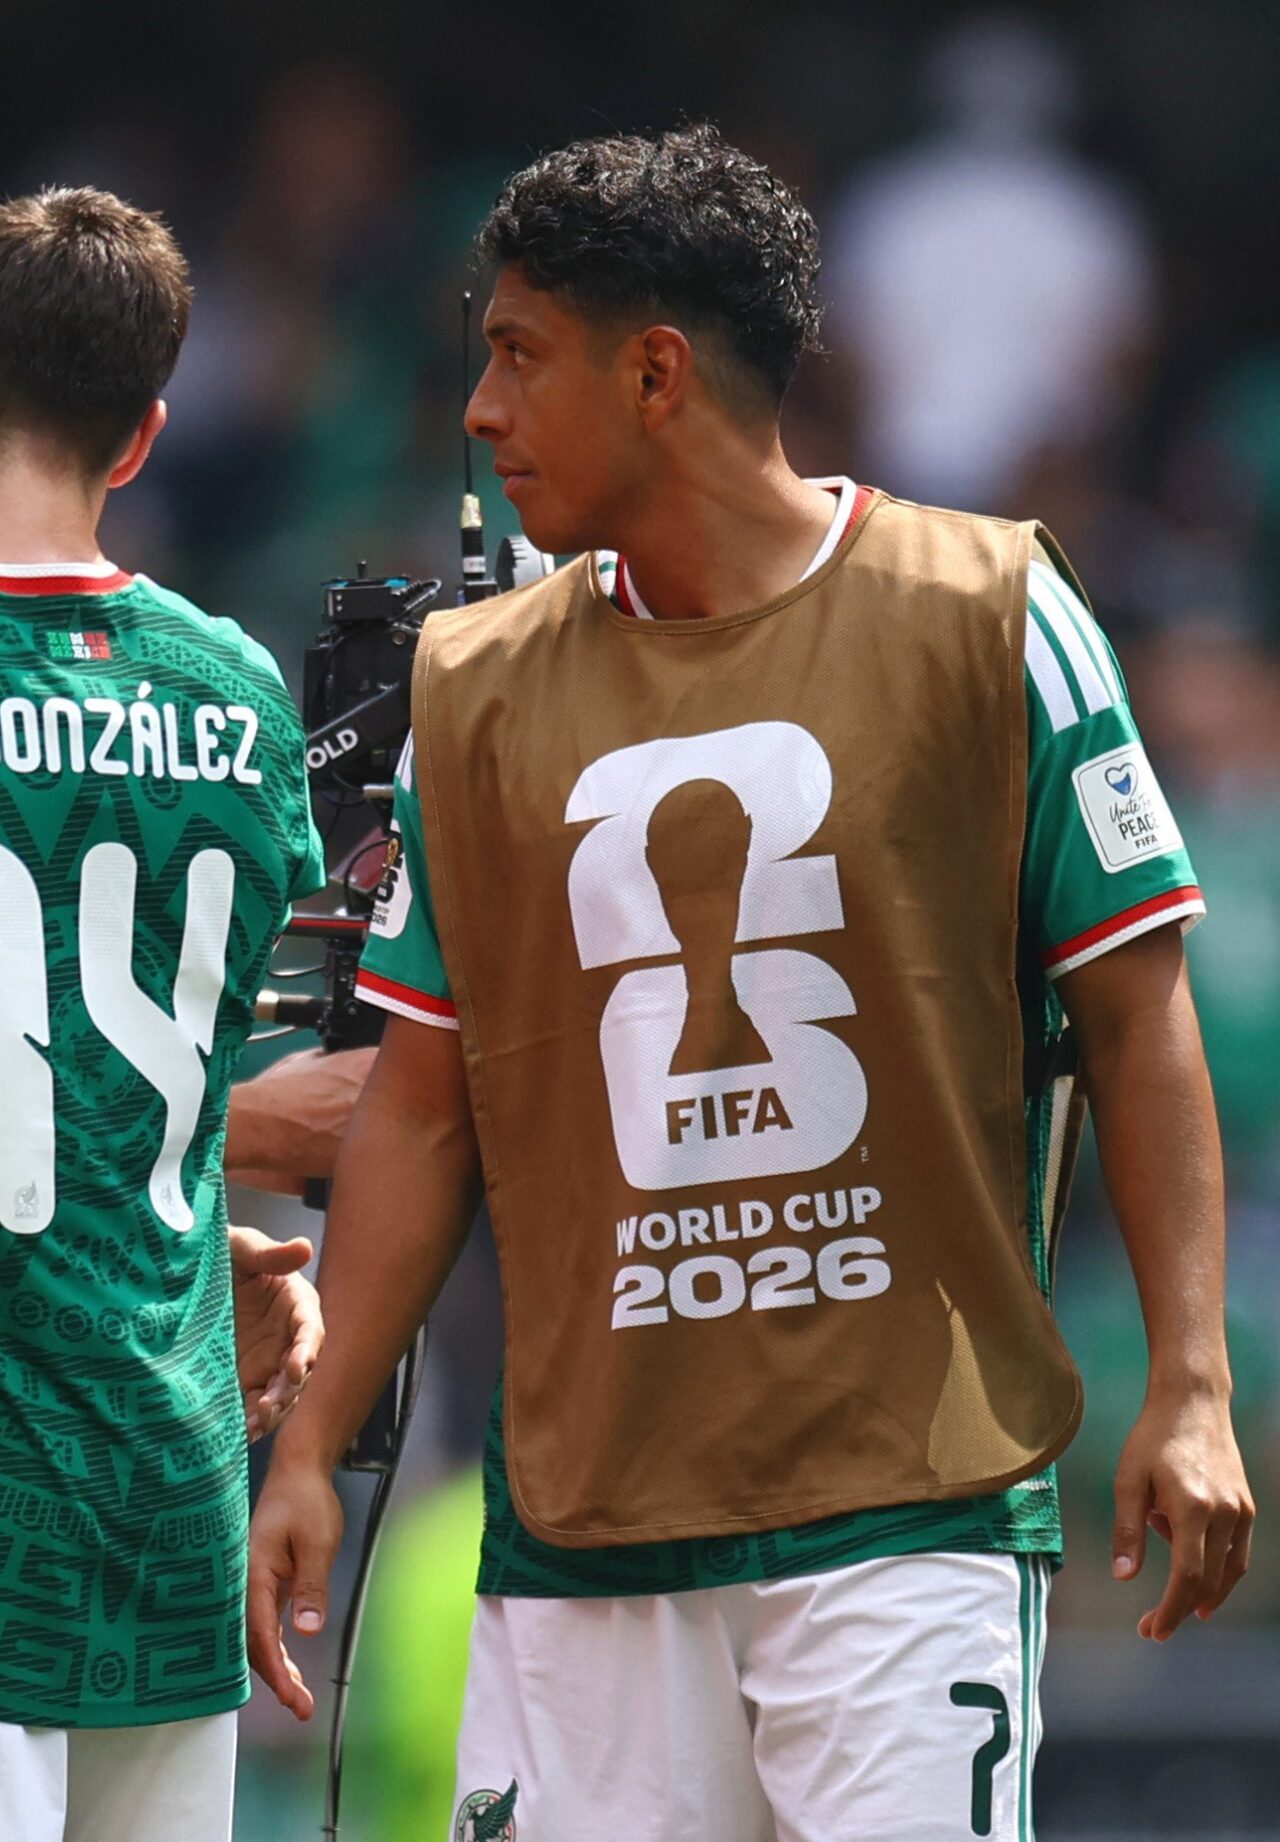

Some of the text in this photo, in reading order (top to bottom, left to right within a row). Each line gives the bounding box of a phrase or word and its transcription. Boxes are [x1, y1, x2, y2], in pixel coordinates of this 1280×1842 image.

[1134, 834, 1158, 850] FIFA
[372, 911, 388, 927] 026
[665, 1087, 794, 1145] FIFA
[616, 1186, 883, 1257] WORLD CUP
[611, 1236, 892, 1331] 2026
[948, 1681, 1011, 1837] 7
